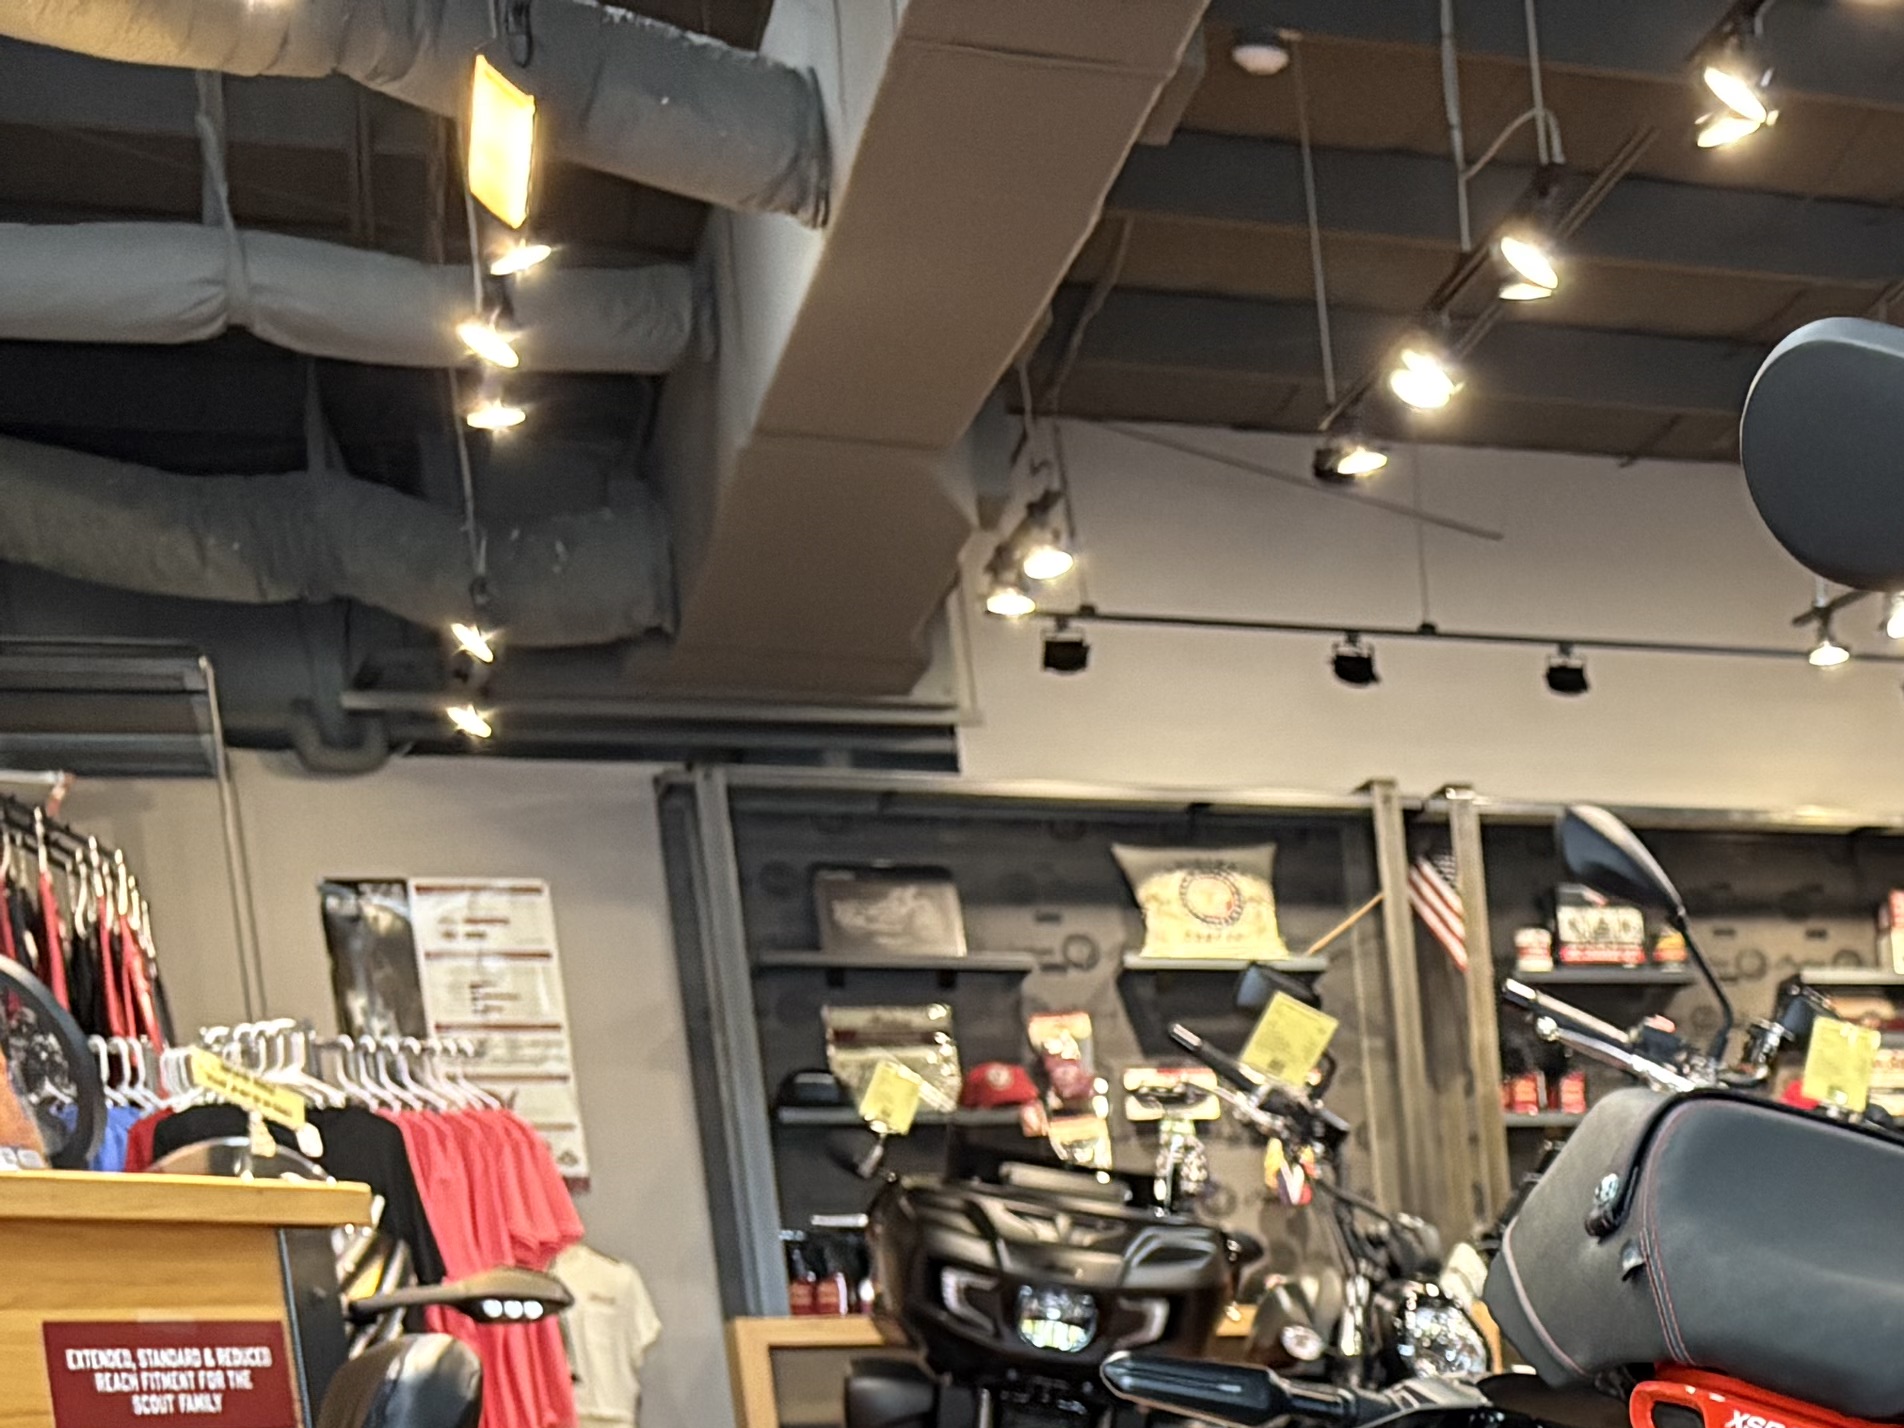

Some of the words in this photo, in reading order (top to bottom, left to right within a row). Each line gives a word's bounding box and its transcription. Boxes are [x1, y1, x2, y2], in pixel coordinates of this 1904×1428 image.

[65, 1348, 137, 1371] EXTENDED,
[137, 1347, 202, 1369] STANDARD
[203, 1347, 214, 1368] &
[215, 1346, 273, 1367] REDUCED
[94, 1371, 140, 1393] REACH
[141, 1371, 196, 1392] FITMENT
[198, 1370, 225, 1390] FOR
[227, 1369, 254, 1390] THE
[131, 1394, 175, 1415] SCOUT
[178, 1393, 224, 1414] FAMILY
